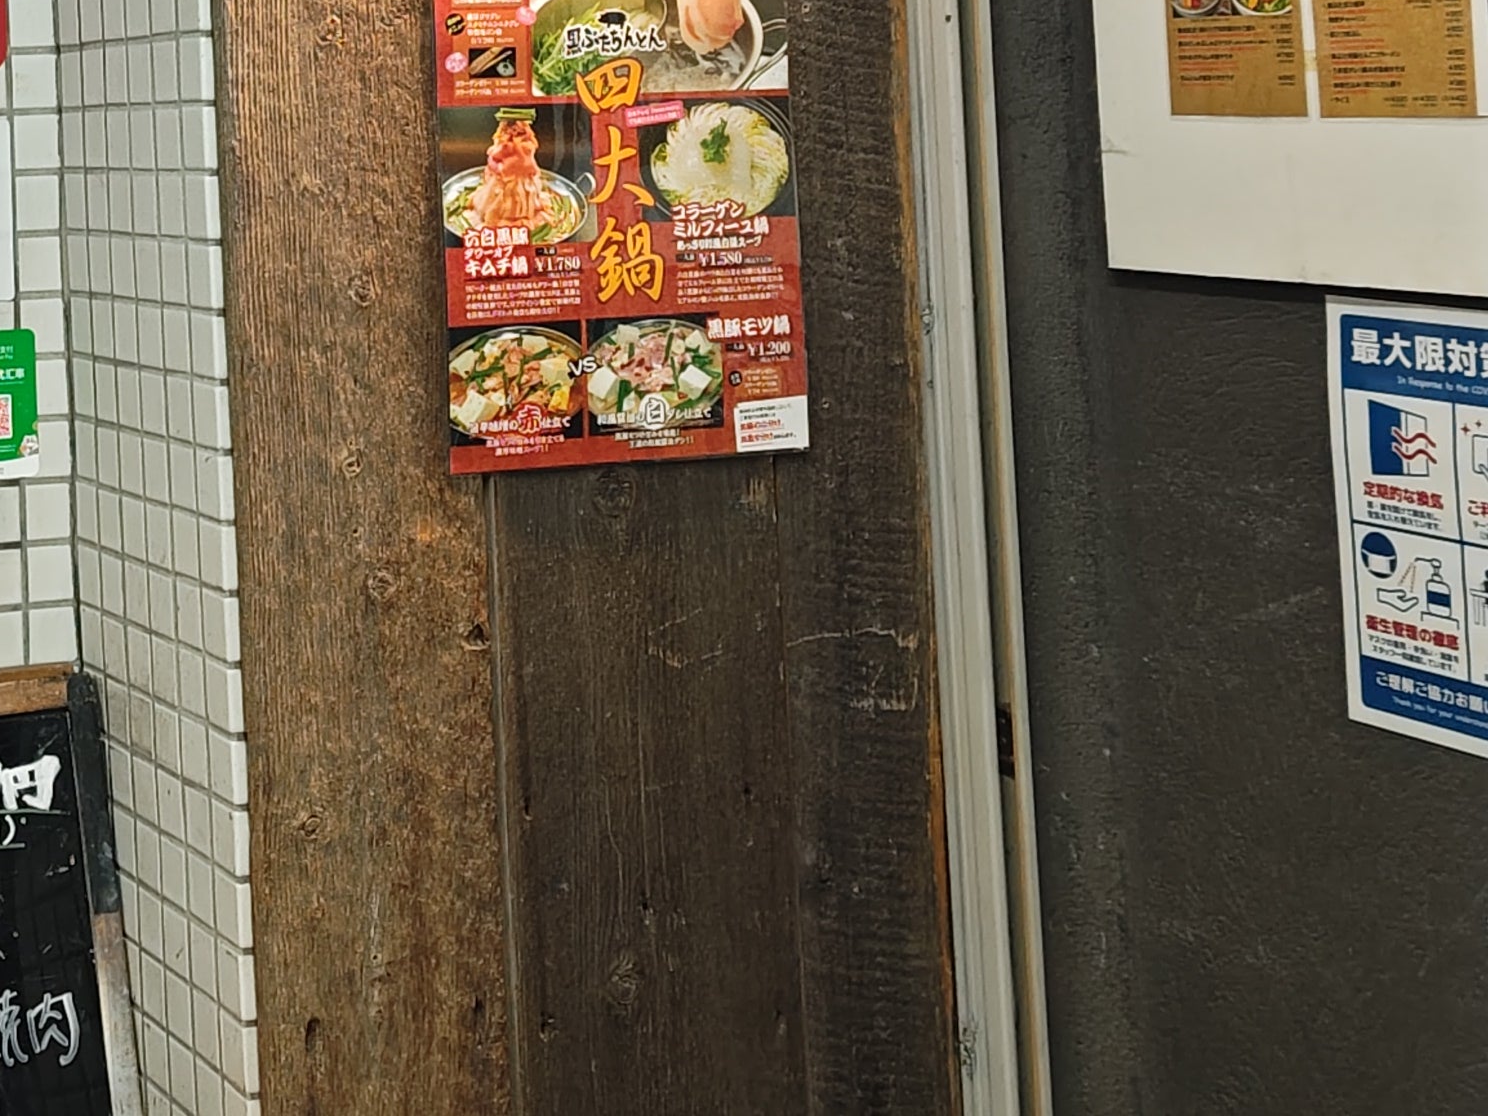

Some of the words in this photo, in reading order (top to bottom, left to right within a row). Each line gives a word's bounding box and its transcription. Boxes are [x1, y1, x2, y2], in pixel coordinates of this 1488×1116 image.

[576, 58, 665, 303] 四大鍋
[672, 200, 744, 221] コラーゲン
[673, 216, 770, 238] ミルフィーユ鍋
[465, 256, 529, 277] キムチ鍋
[747, 341, 791, 356] ¥1,200
[1350, 327, 1488, 380] 最大限対
[1363, 481, 1444, 510] 定期的な換気
[1366, 614, 1459, 651] 衛生管理の徹底
